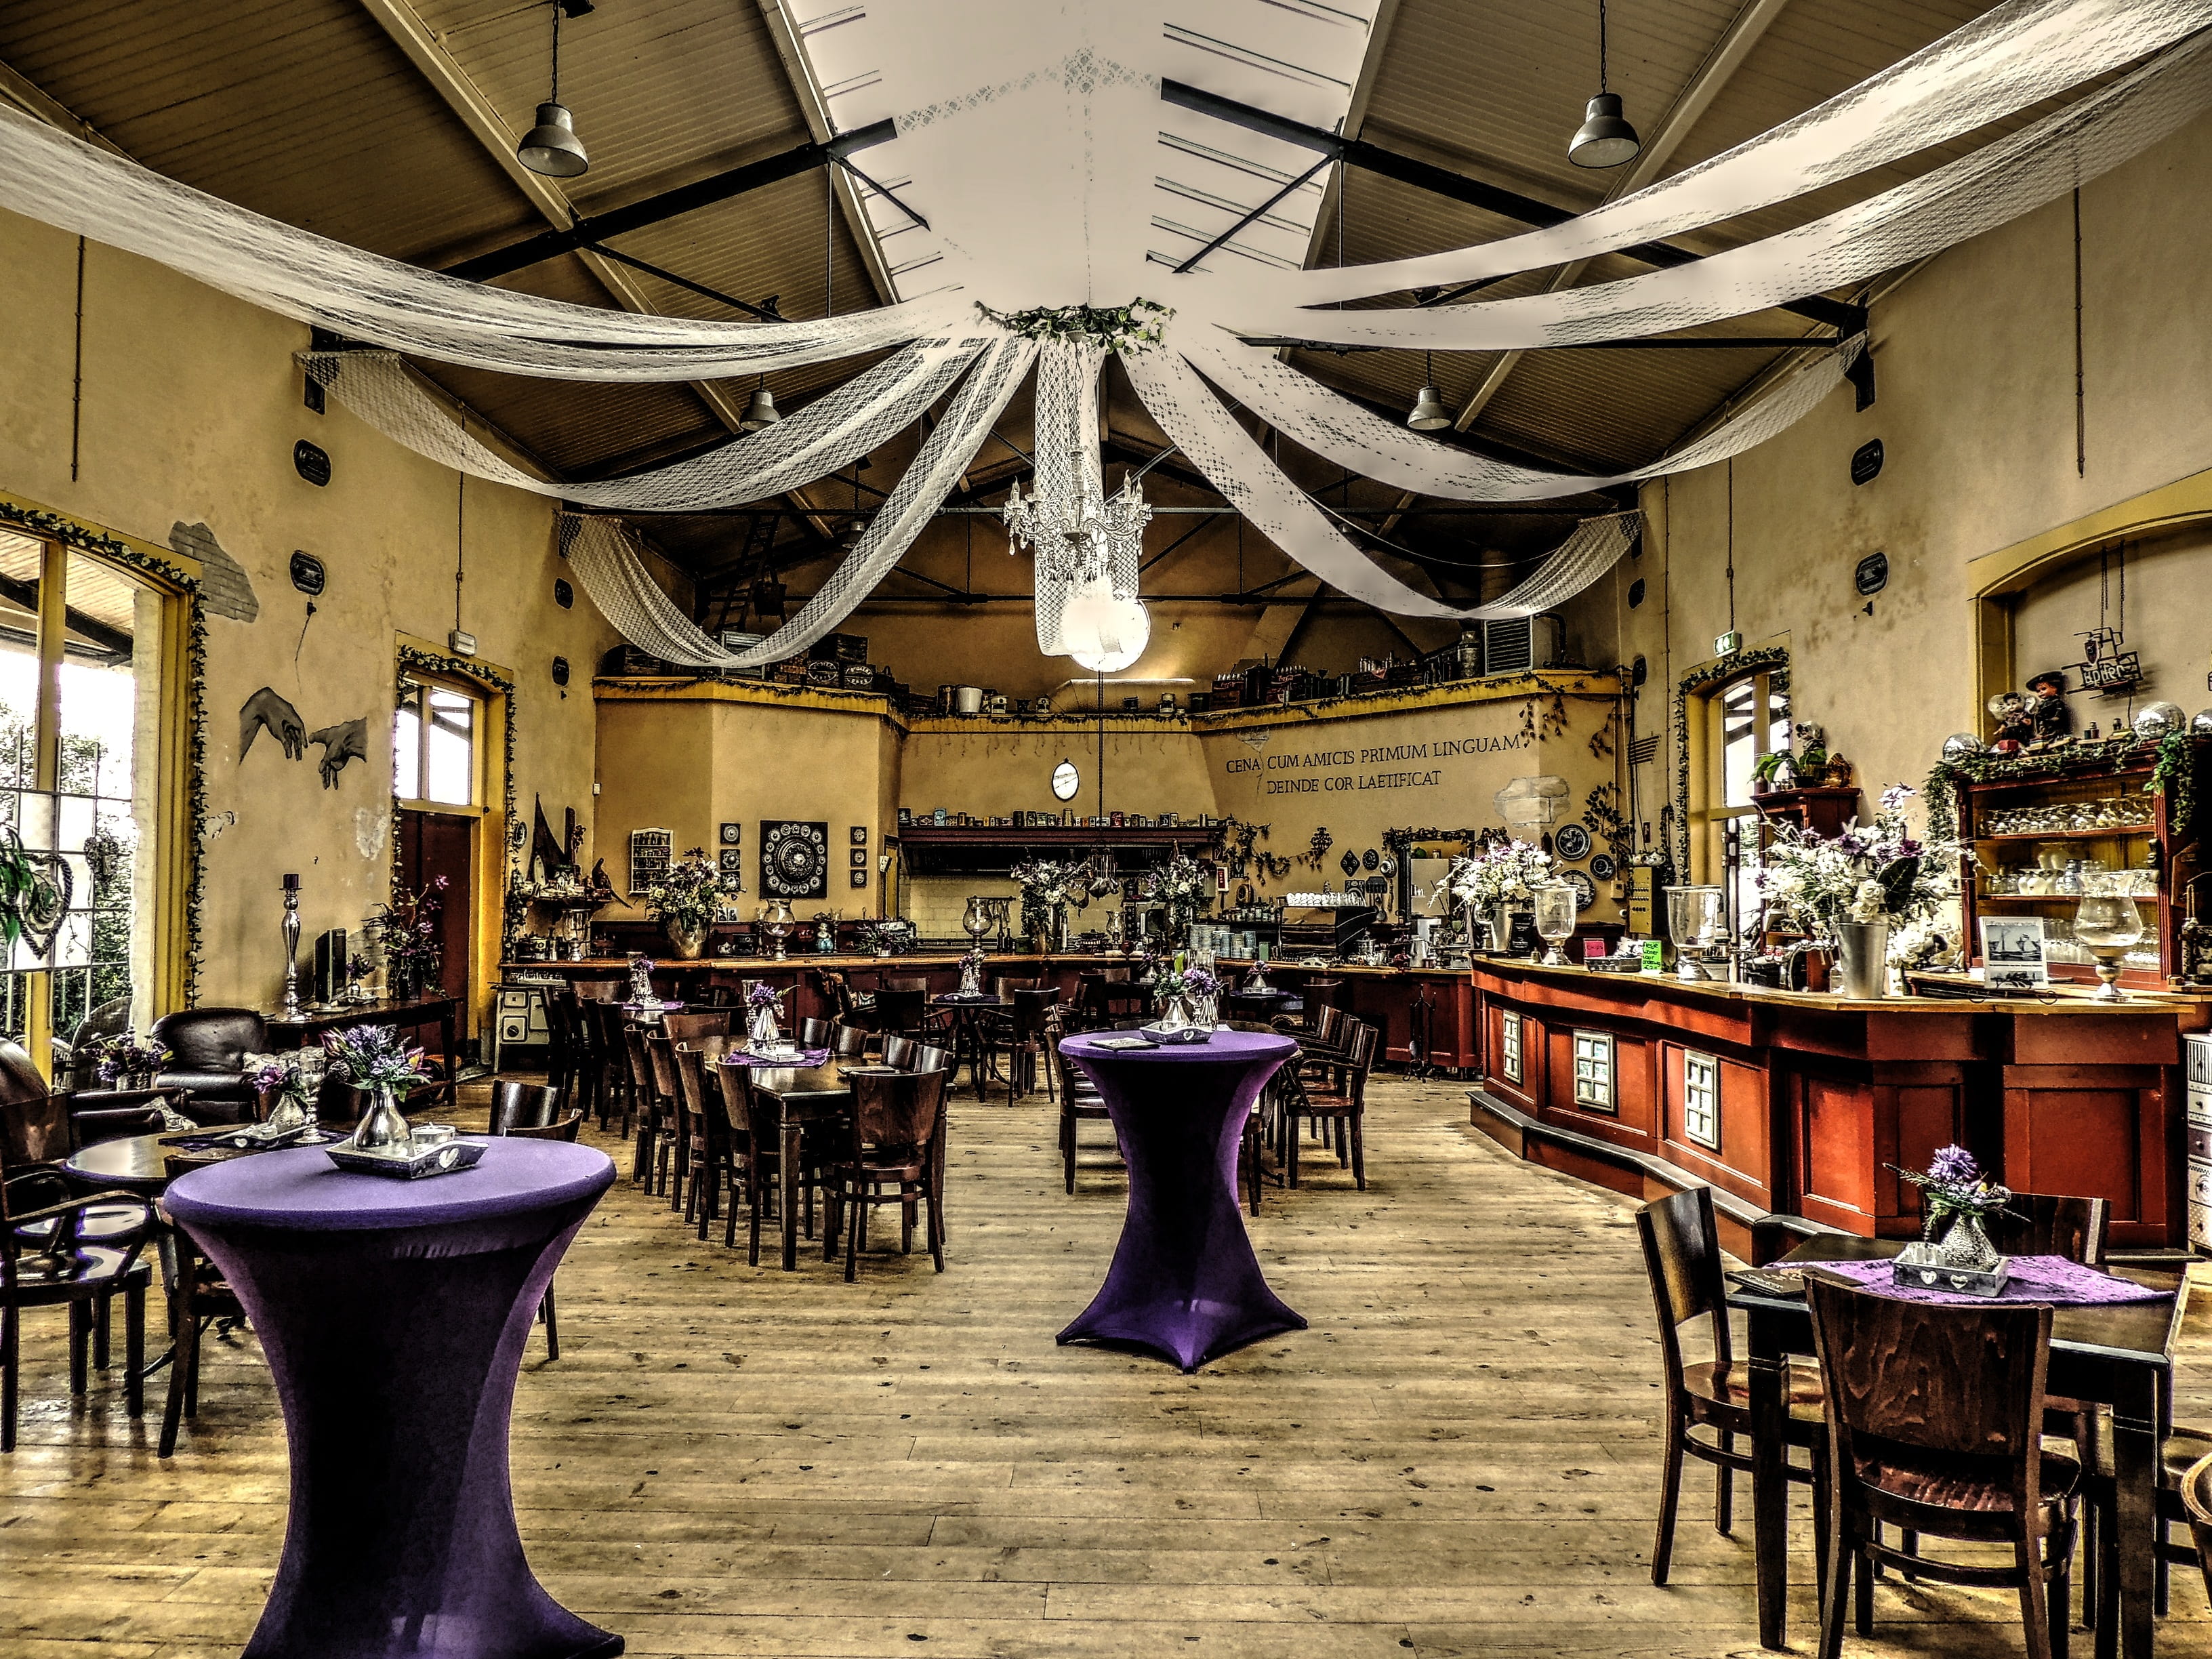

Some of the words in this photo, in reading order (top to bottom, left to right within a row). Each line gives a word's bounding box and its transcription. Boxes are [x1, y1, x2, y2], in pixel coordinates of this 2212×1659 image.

[1227, 758, 1261, 773] CENA
[1267, 754, 1299, 770] CUM
[1303, 750, 1355, 767] AMICIS
[1361, 743, 1427, 763] PRIMUM
[1433, 734, 1521, 757] LINGUAM
[1267, 779, 1319, 794] DEINDE
[1324, 777, 1354, 791] COR
[1357, 771, 1441, 790] LAETIFICAT
